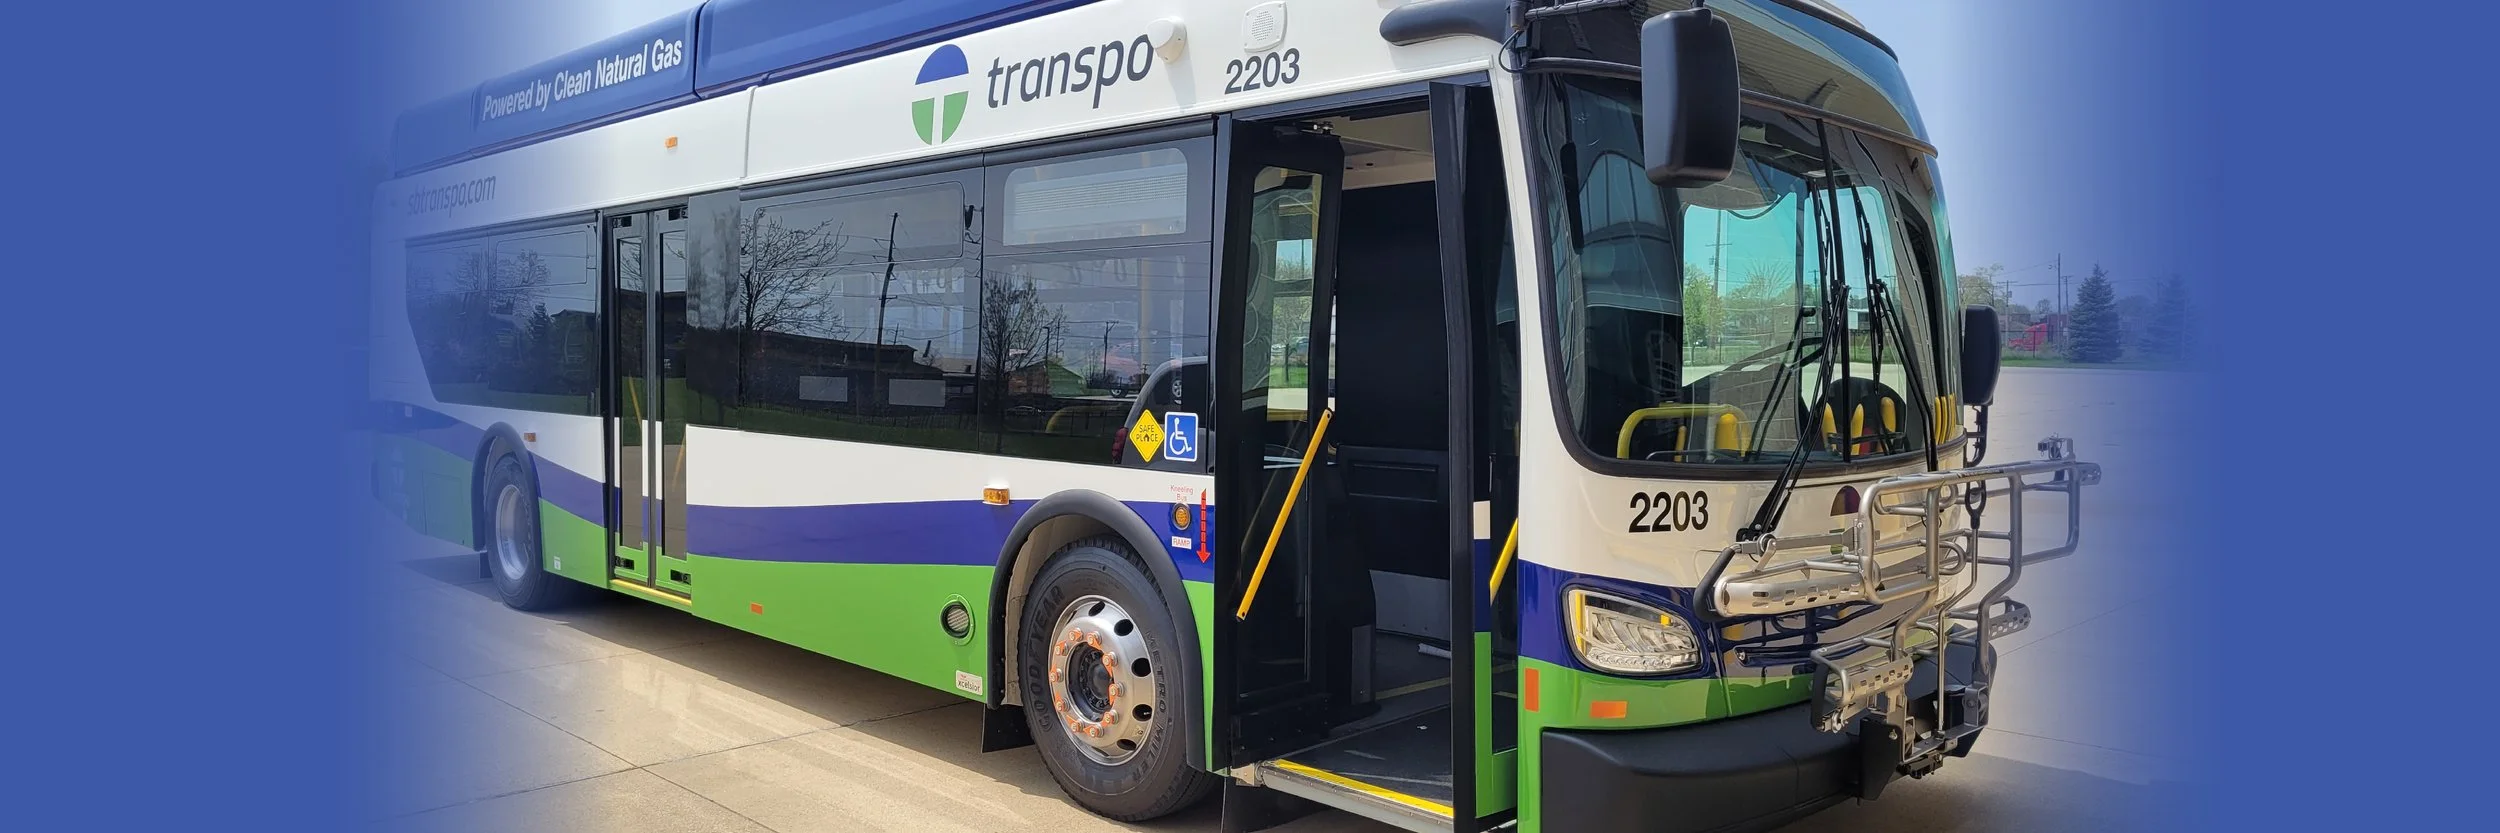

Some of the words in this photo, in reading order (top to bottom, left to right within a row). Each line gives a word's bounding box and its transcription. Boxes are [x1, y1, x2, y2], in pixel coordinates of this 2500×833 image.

[482, 80, 534, 121] Powered
[535, 79, 551, 112] by
[553, 70, 591, 101] Clean
[594, 43, 649, 89] Natural
[651, 38, 683, 73] Gas
[987, 34, 1154, 109] transpo
[1224, 47, 1300, 95] 2203
[407, 175, 496, 218] sbtranspo.com
[1139, 424, 1155, 433] SAFE
[1170, 485, 1193, 495] Kneeling
[1177, 493, 1187, 501] Bus
[1629, 490, 1708, 533] 2203
[1173, 538, 1190, 547] RAMP
[1145, 629, 1167, 713] METRO
